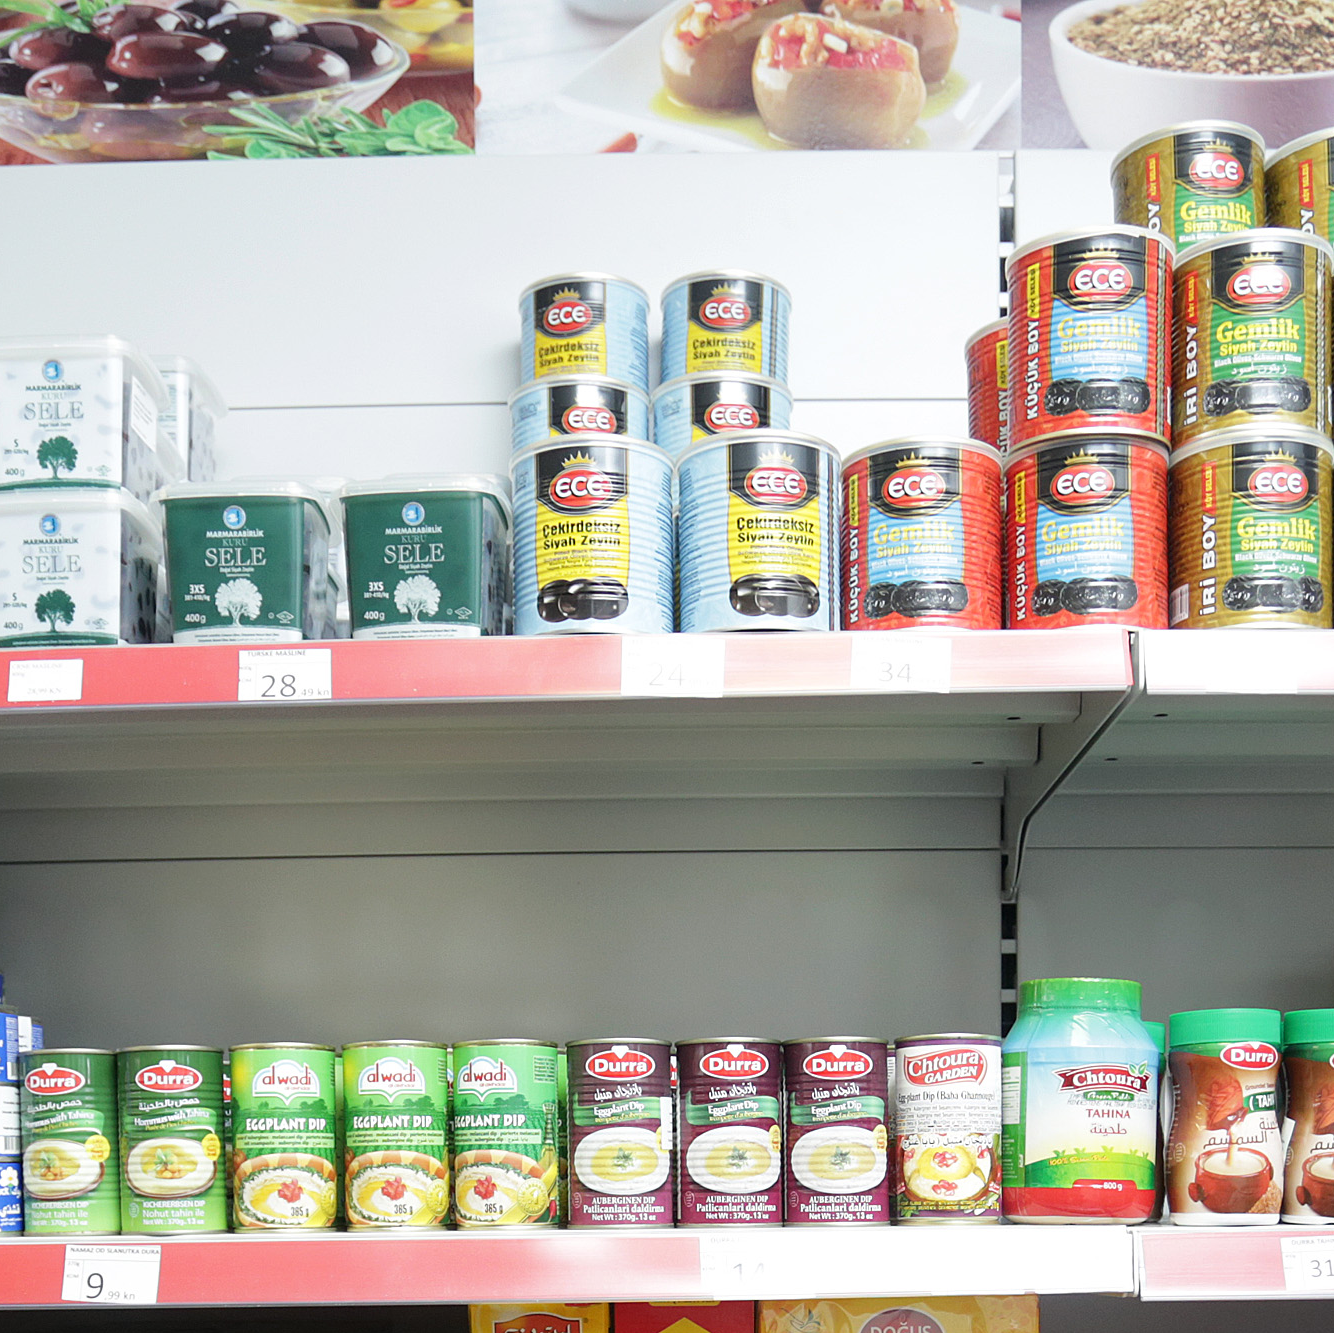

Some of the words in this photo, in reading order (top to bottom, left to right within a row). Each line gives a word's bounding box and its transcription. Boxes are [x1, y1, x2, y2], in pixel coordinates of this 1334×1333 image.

[1181, 202, 1251, 224] Gemlik
[1075, 269, 1125, 289] ECE
[548, 305, 586, 322] ECE
[1026, 319, 1039, 356] BOY
[1216, 321, 1299, 342] Gemlik
[1184, 325, 1198, 378] BOY
[1219, 340, 1258, 354] Siyah
[1262, 340, 1296, 353] Zeytin
[1026, 358, 1039, 419] KÜÇÜK
[24, 401, 84, 421] SELE
[555, 478, 606, 497] ECE
[1256, 475, 1303, 492] ECE
[543, 518, 621, 537] Çekirdeksiz
[1237, 518, 1316, 540] Gemlik
[223, 538, 248, 546] KURU
[204, 546, 267, 568] SELE
[383, 542, 445, 564] SELE
[189, 585, 204, 594] 3XS
[317, 688, 330, 697] kn
[595, 1056, 647, 1073] Durra
[907, 1050, 981, 1079] Chtoura
[924, 1064, 979, 1084] GARDEN
[142, 1072, 194, 1087] Durra
[1085, 1108, 1131, 1120] TAHINA
[245, 1117, 305, 1131] EGGPLANT
[308, 1117, 327, 1131] DIP
[592, 1196, 640, 1204] AUBERGINEN
[643, 1196, 655, 1204] DIP
